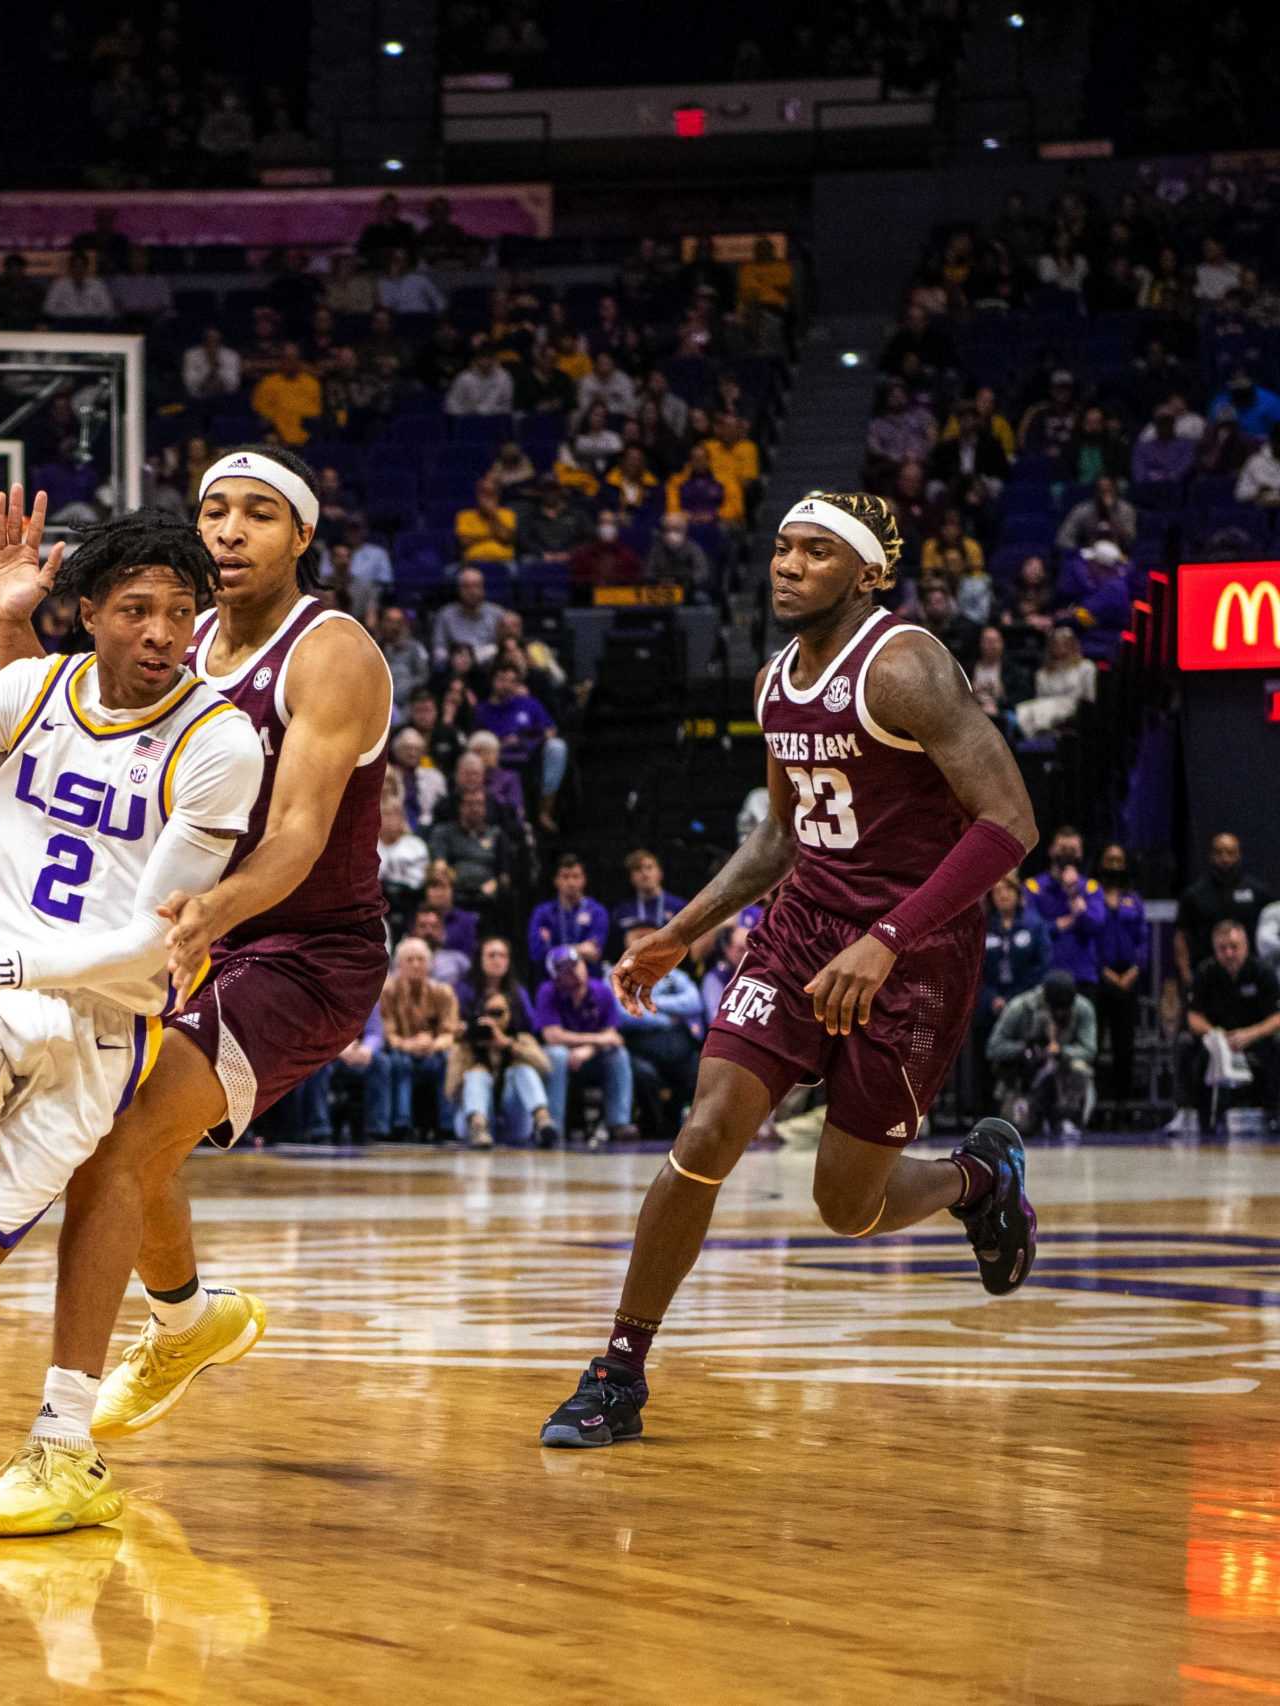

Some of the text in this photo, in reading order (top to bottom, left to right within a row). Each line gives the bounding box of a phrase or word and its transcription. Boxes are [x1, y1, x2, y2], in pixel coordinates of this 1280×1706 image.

[765, 732, 863, 761] TEXAS A&M
[15, 752, 147, 841] LSU
[785, 766, 859, 849] 23
[31, 833, 95, 923] 2
